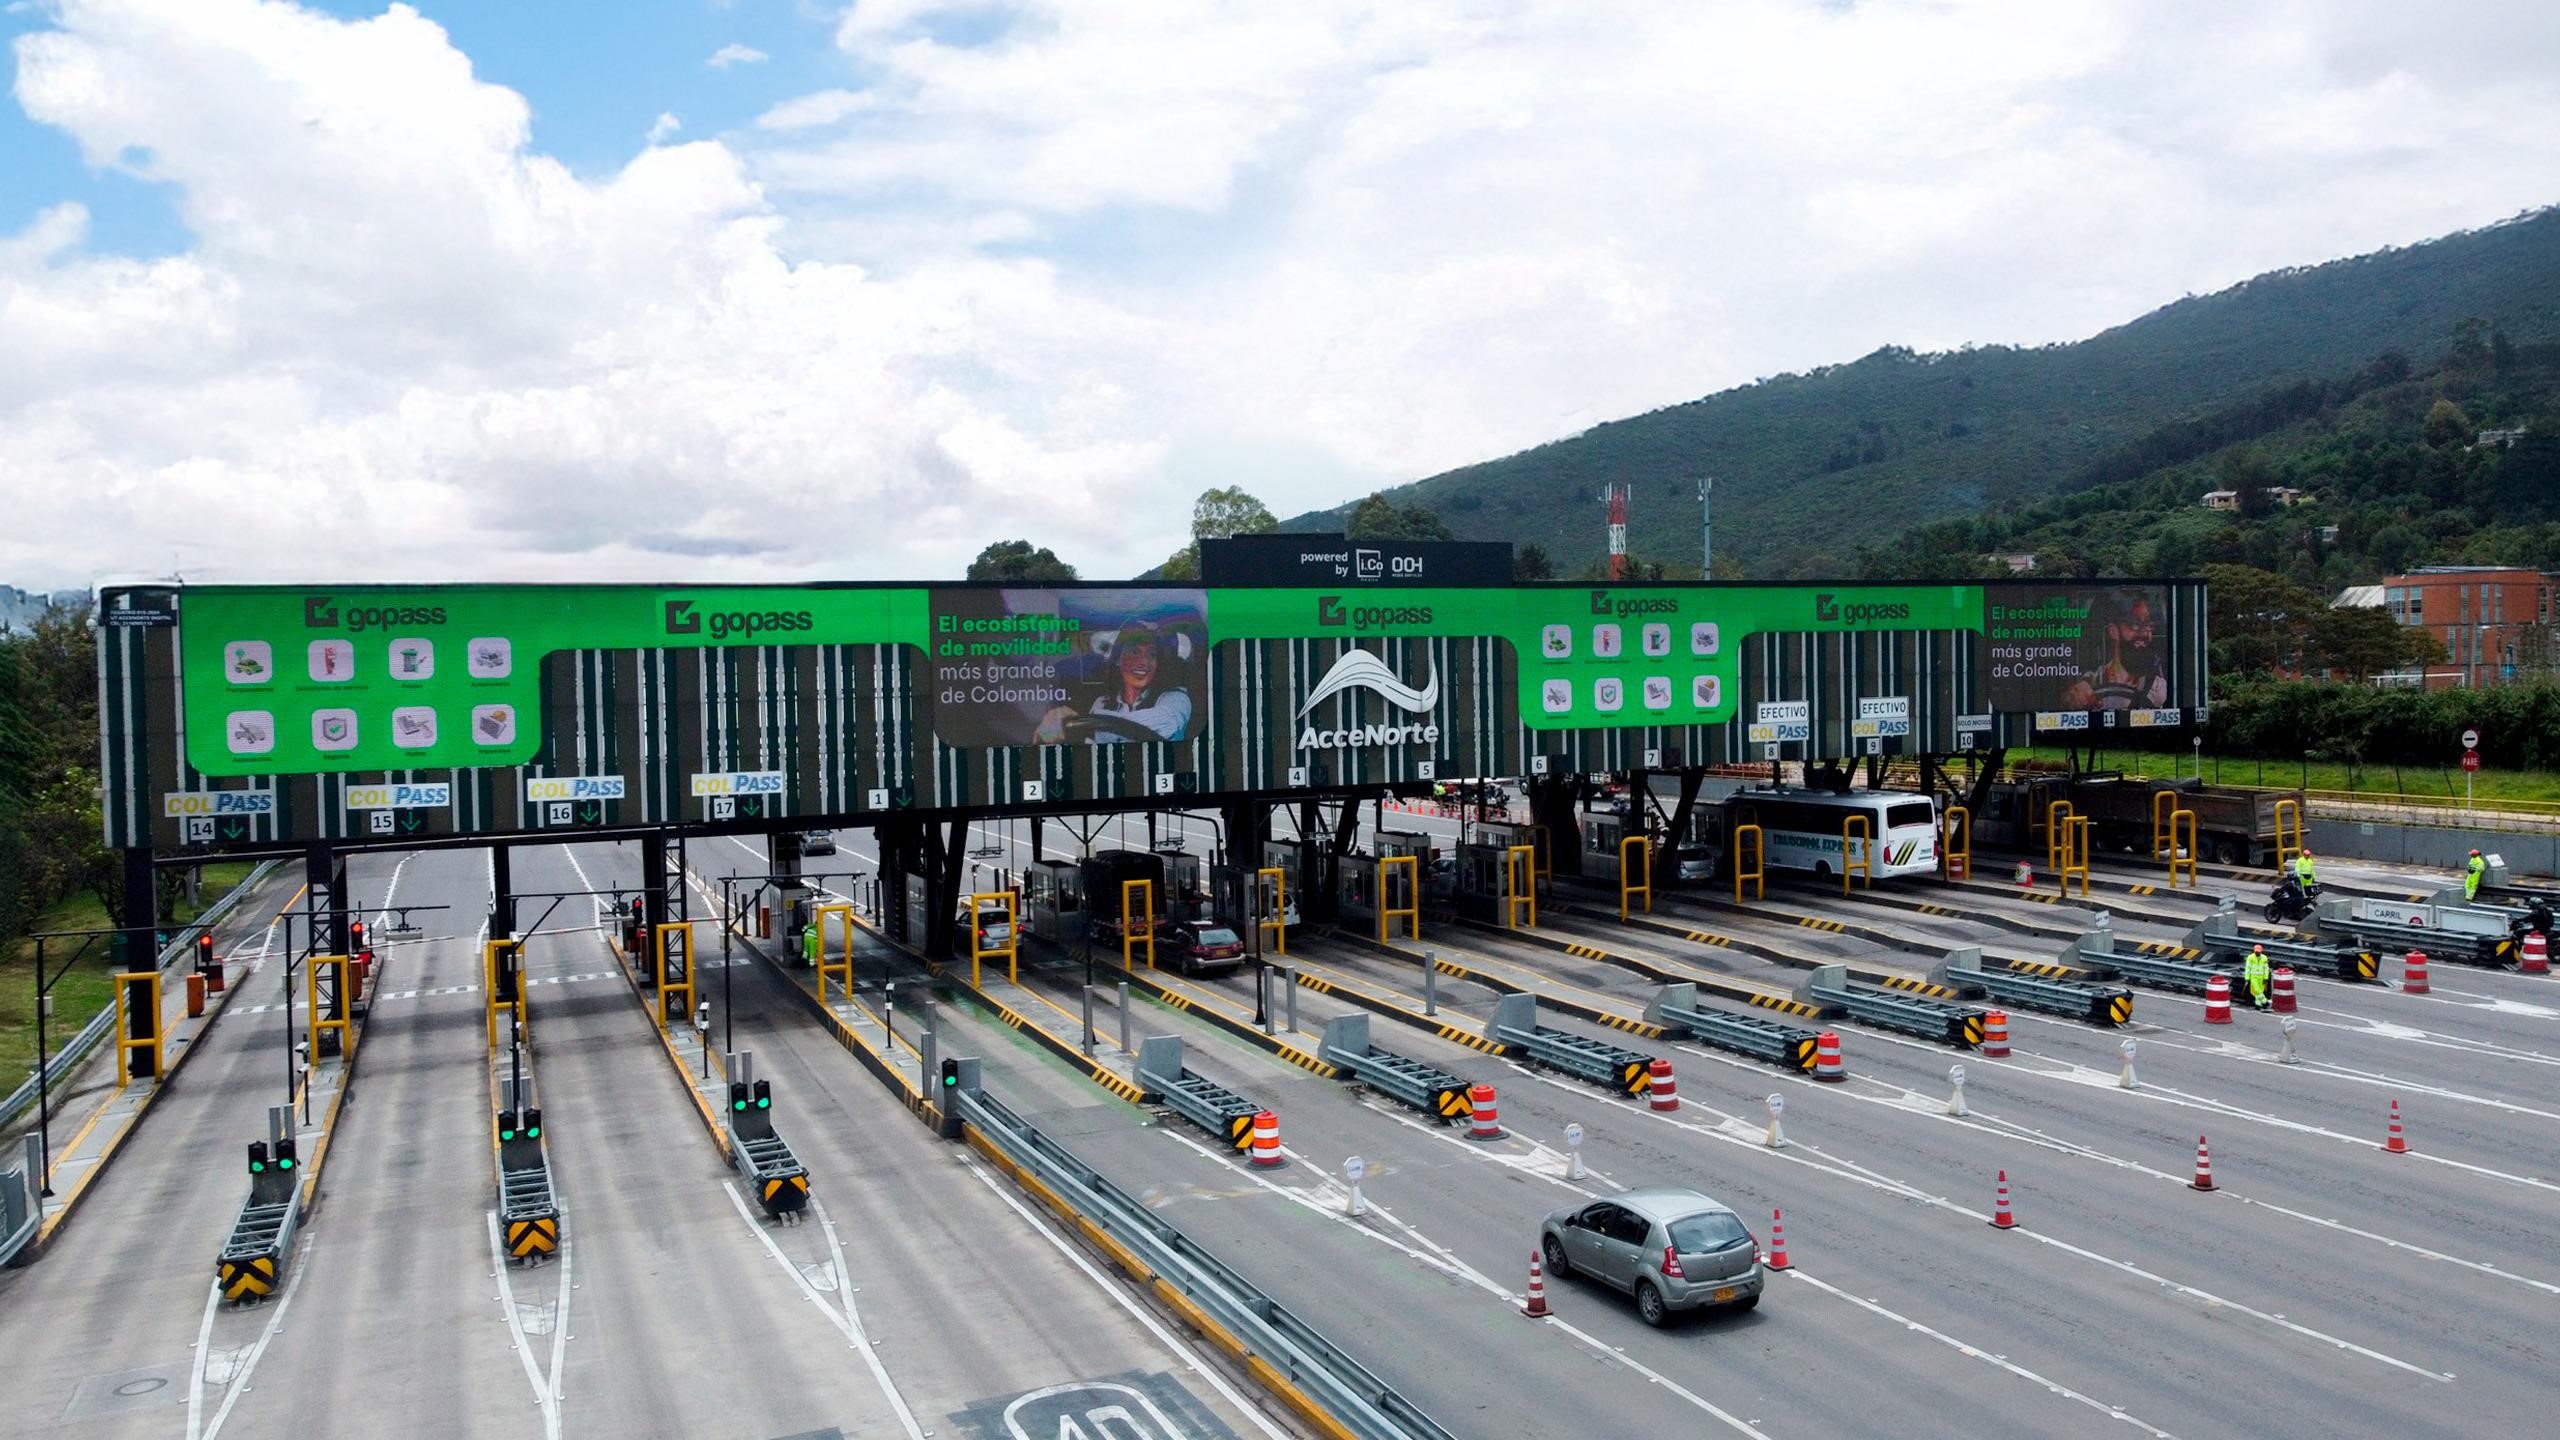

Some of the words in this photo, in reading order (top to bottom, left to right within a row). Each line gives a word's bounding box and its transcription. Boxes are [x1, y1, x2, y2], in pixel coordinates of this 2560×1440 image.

[1300, 551, 1349, 565] powered
[1335, 563, 1349, 578] by
[1617, 599, 1679, 618] gopass
[1844, 602, 1909, 624] gopass
[1992, 605, 2006, 620] El
[2008, 605, 2089, 620] ecosistema
[347, 603, 447, 632] gopass
[708, 609, 813, 639] gopass
[939, 615, 958, 633] El
[962, 613, 1081, 633] ecosistema
[1353, 605, 1434, 632] gopass
[1992, 625, 2010, 639] de
[2014, 624, 2082, 639] movilidad
[940, 638, 965, 656] de
[970, 637, 1071, 656] movilidad
[1992, 643, 2022, 658] más
[2025, 643, 2072, 661] grande
[940, 661, 982, 680] más
[987, 661, 1056, 683] grande
[1992, 664, 2011, 677] de
[2014, 662, 2083, 677] Colombia.
[941, 686, 966, 704] de
[971, 684, 1072, 703] Colombia.
[1760, 705, 1807, 719] EFECTIVO
[1861, 701, 1907, 715] EFECTIVO
[2195, 710, 2206, 720] 12
[2103, 714, 2114, 725] 11
[1297, 721, 1439, 750] AcceNorte
[1962, 735, 1972, 745] 10
[1768, 746, 1775, 757] 8
[1870, 741, 1876, 751] 9
[1536, 759, 1543, 770] 6
[1648, 752, 1655, 763] 7
[1294, 770, 1301, 782] 4
[1423, 764, 1430, 776] 5
[1161, 776, 1168, 788] 3
[1029, 783, 1037, 796] 2
[875, 792, 882, 806] 1
[552, 807, 570, 820] 16
[716, 802, 732, 814] 17
[373, 815, 392, 828] 15
[191, 823, 212, 836] 14
[2374, 909, 2402, 919] CARRIL
